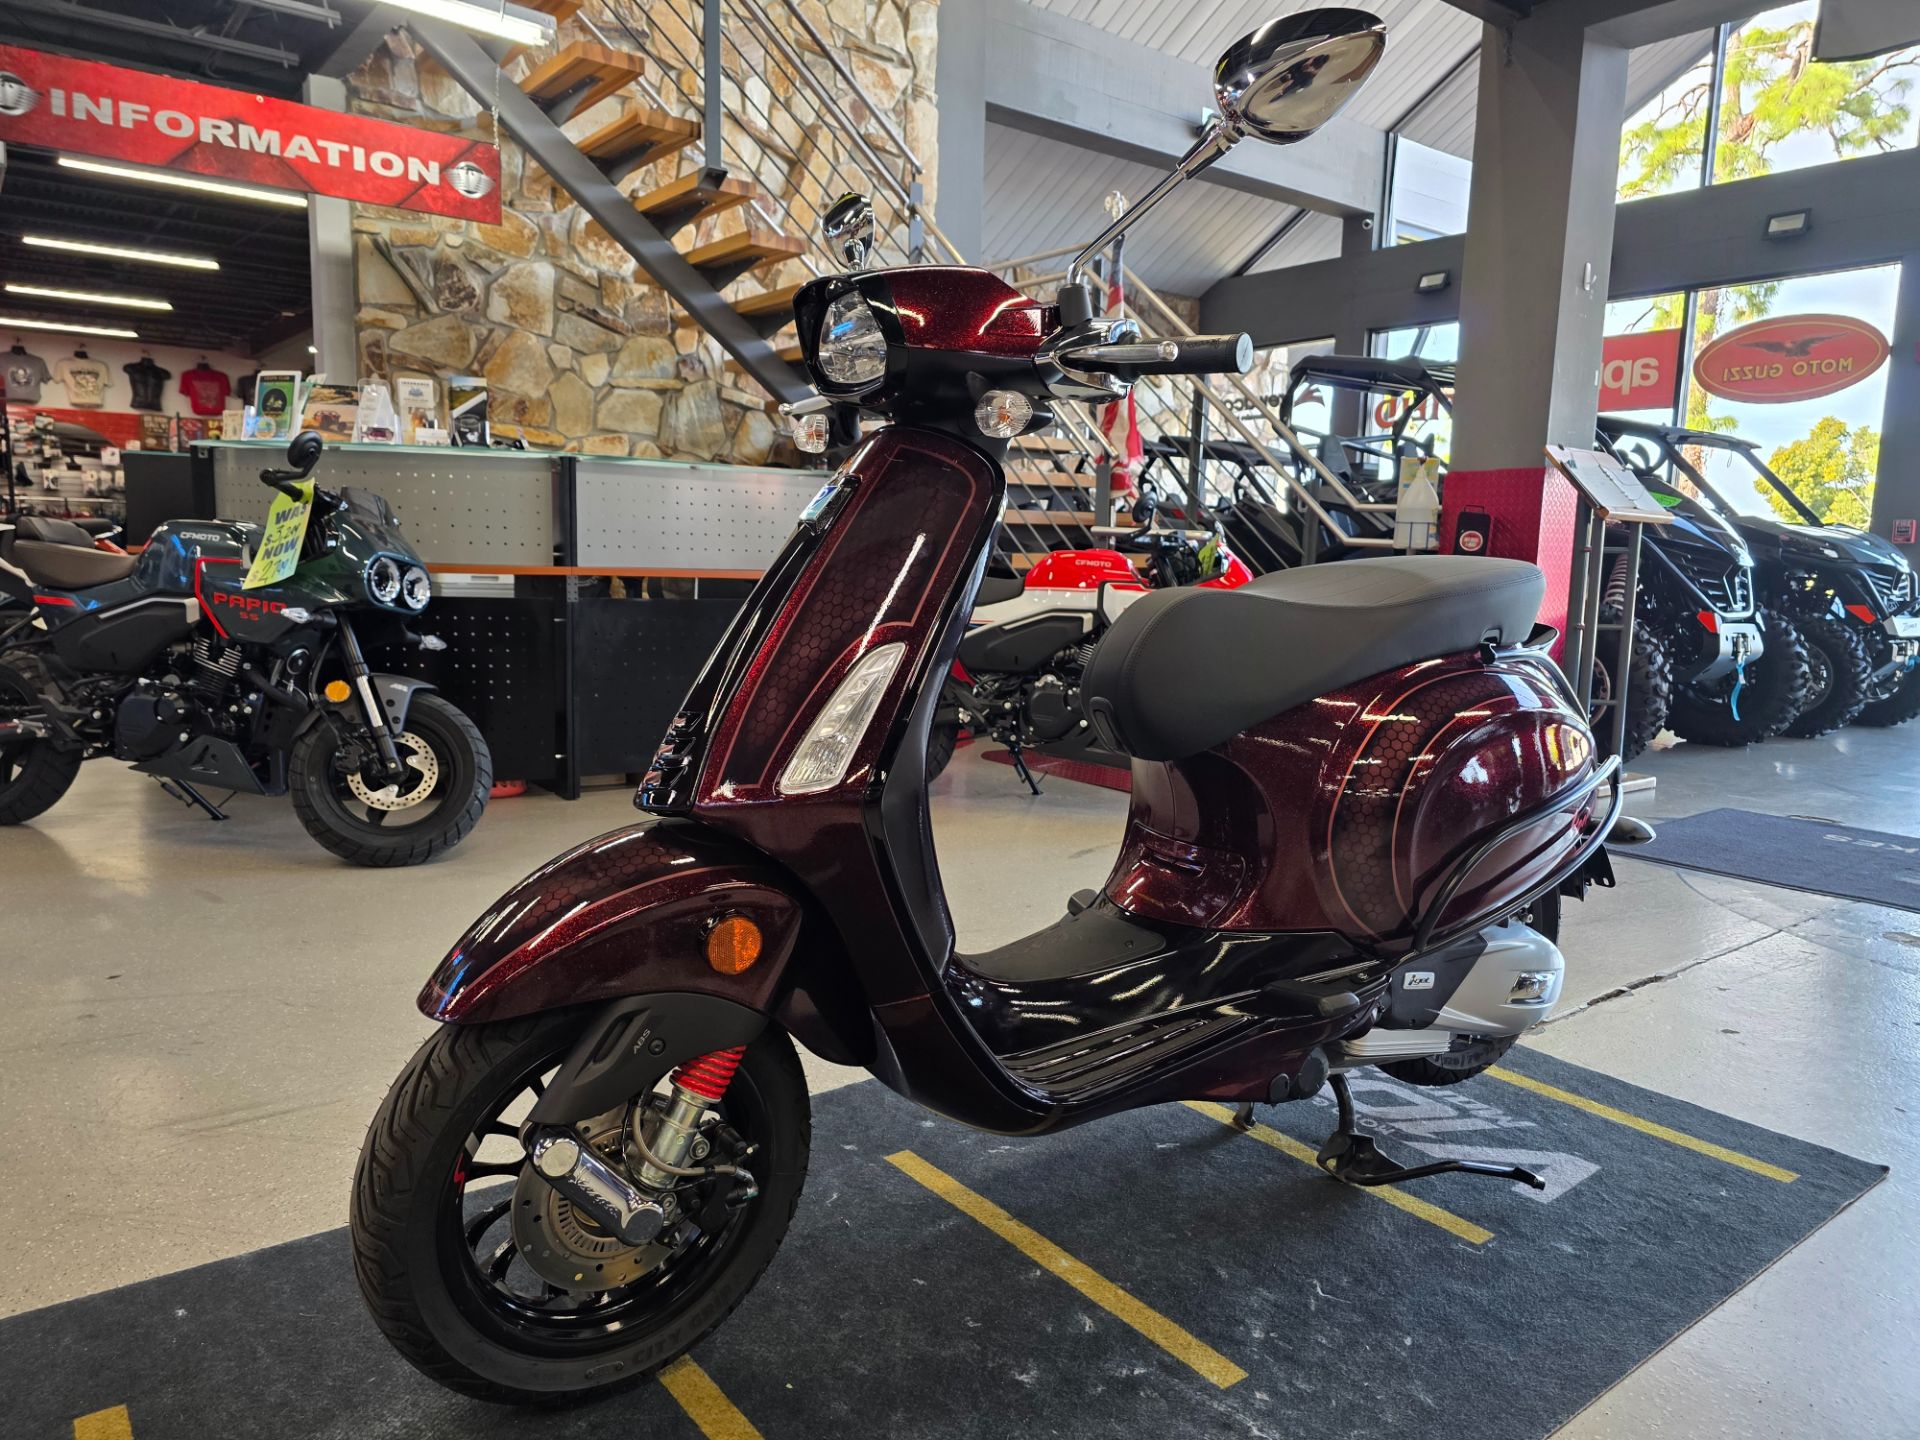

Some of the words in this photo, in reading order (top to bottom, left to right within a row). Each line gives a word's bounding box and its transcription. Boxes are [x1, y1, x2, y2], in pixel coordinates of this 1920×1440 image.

[50, 88, 441, 187] INFORMATION
[275, 503, 307, 525] WAS
[180, 531, 220, 542] CFMOTO
[262, 537, 299, 560] NOW
[1075, 559, 1112, 568] CFMOTO
[213, 592, 287, 614] PAPIO
[633, 1029, 650, 1055] ABS
